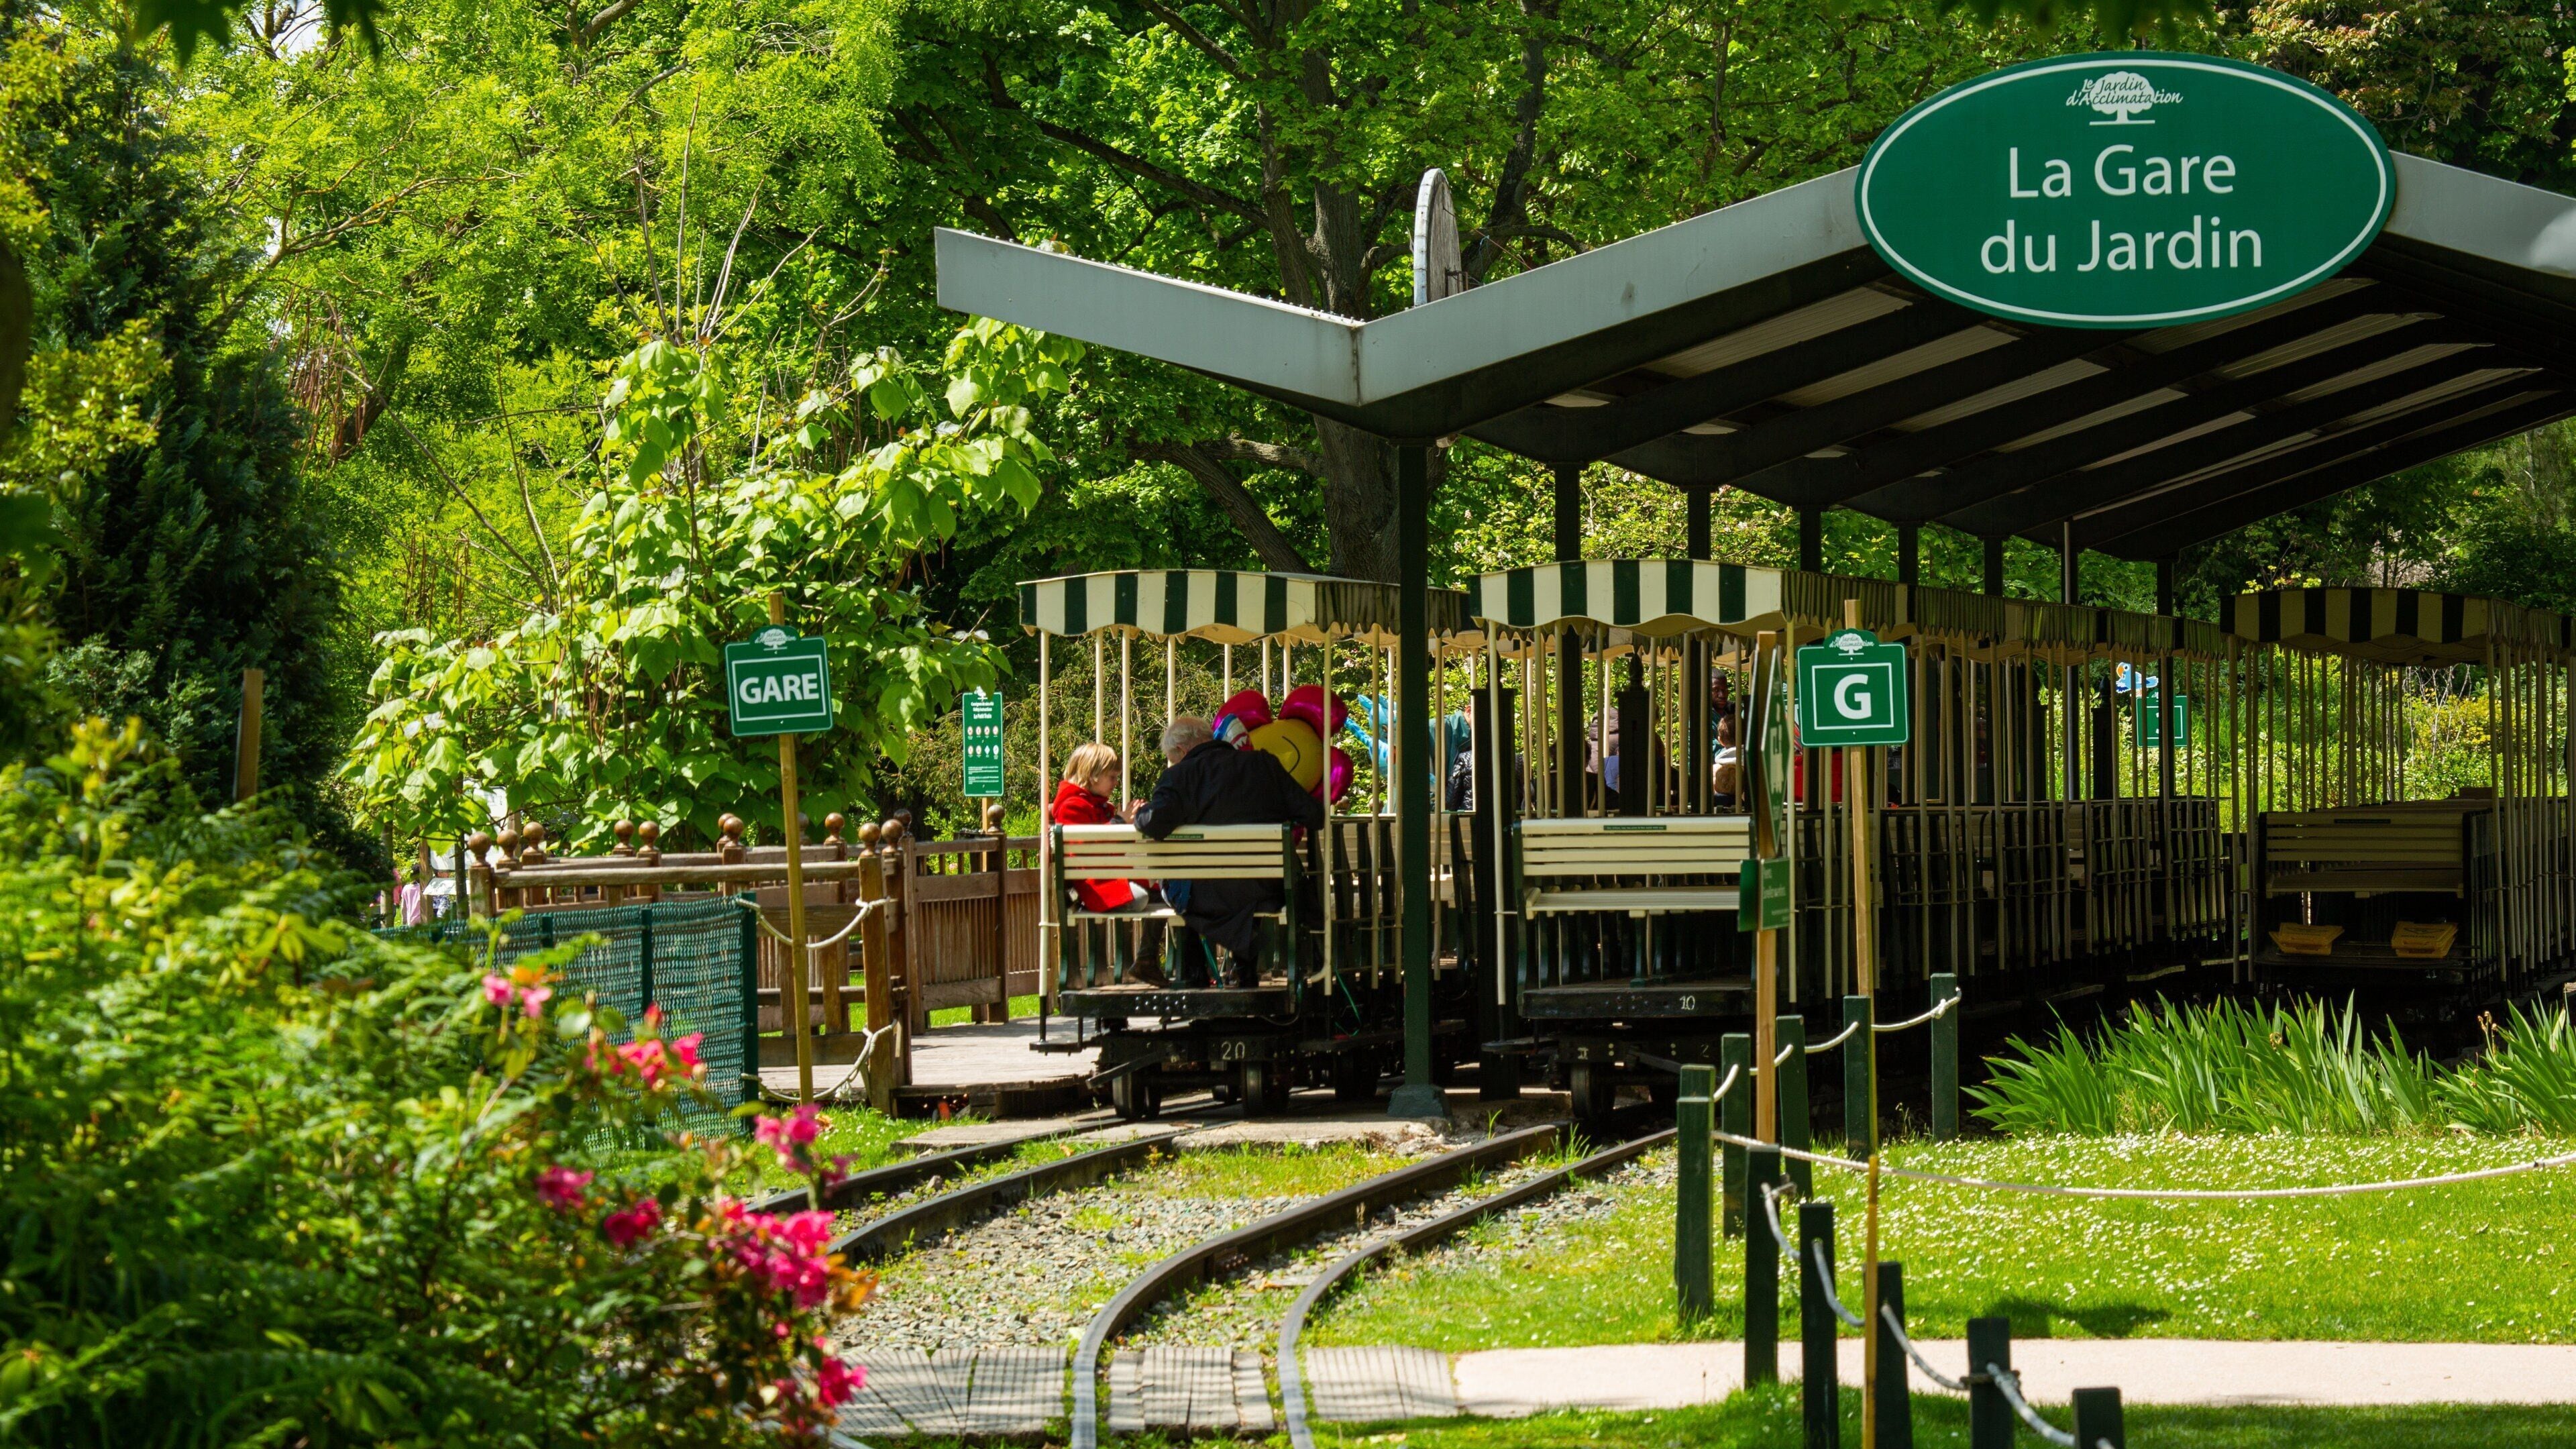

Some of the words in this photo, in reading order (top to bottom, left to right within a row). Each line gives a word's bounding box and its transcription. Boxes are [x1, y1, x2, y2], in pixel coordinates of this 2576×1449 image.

[2065, 89, 2184, 106] d'Acclimatation
[2082, 78, 2094, 92] Le
[2097, 76, 2146, 95] Jardin
[2010, 147, 2072, 198] La
[2094, 144, 2236, 196] Gare
[1980, 219, 2056, 274] du
[2077, 215, 2262, 271] Jardin
[739, 673, 820, 704] GARE
[1833, 674, 1872, 720] G
[1679, 996, 1695, 1010] 10
[1221, 1041, 1245, 1060] 20
